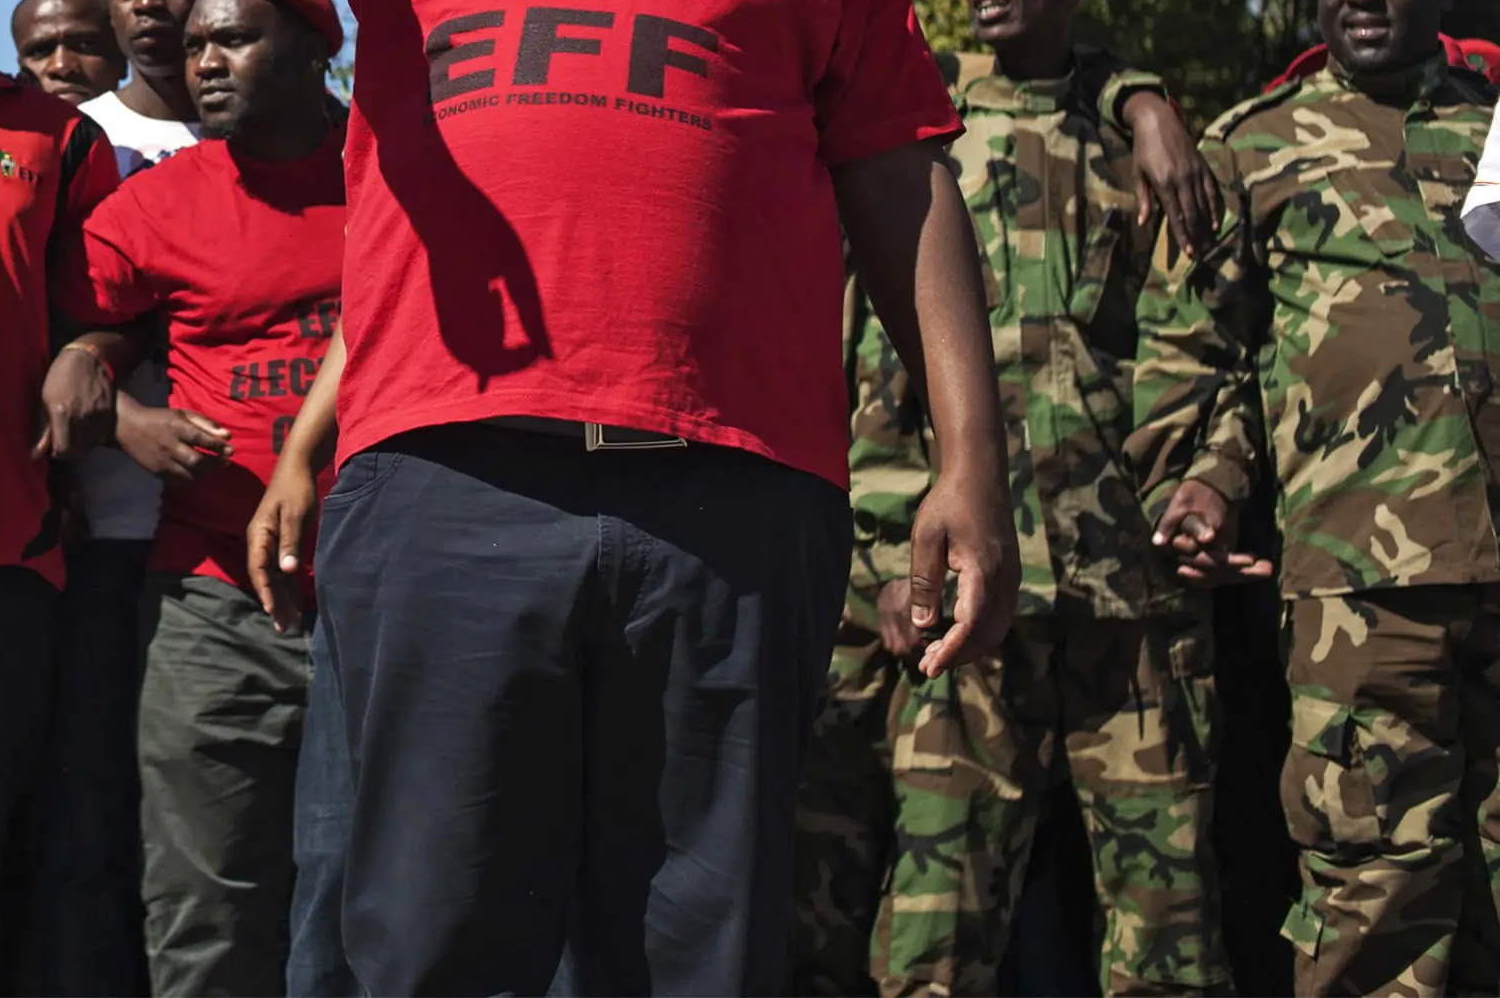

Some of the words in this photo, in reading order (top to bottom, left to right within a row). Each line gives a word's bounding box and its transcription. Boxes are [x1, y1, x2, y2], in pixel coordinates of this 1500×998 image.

[424, 5, 720, 105] EFF
[506, 92, 606, 107] FREEDOM
[615, 97, 713, 131] FIGHTERS
[296, 300, 341, 339] EF
[229, 357, 322, 402] ELEC
